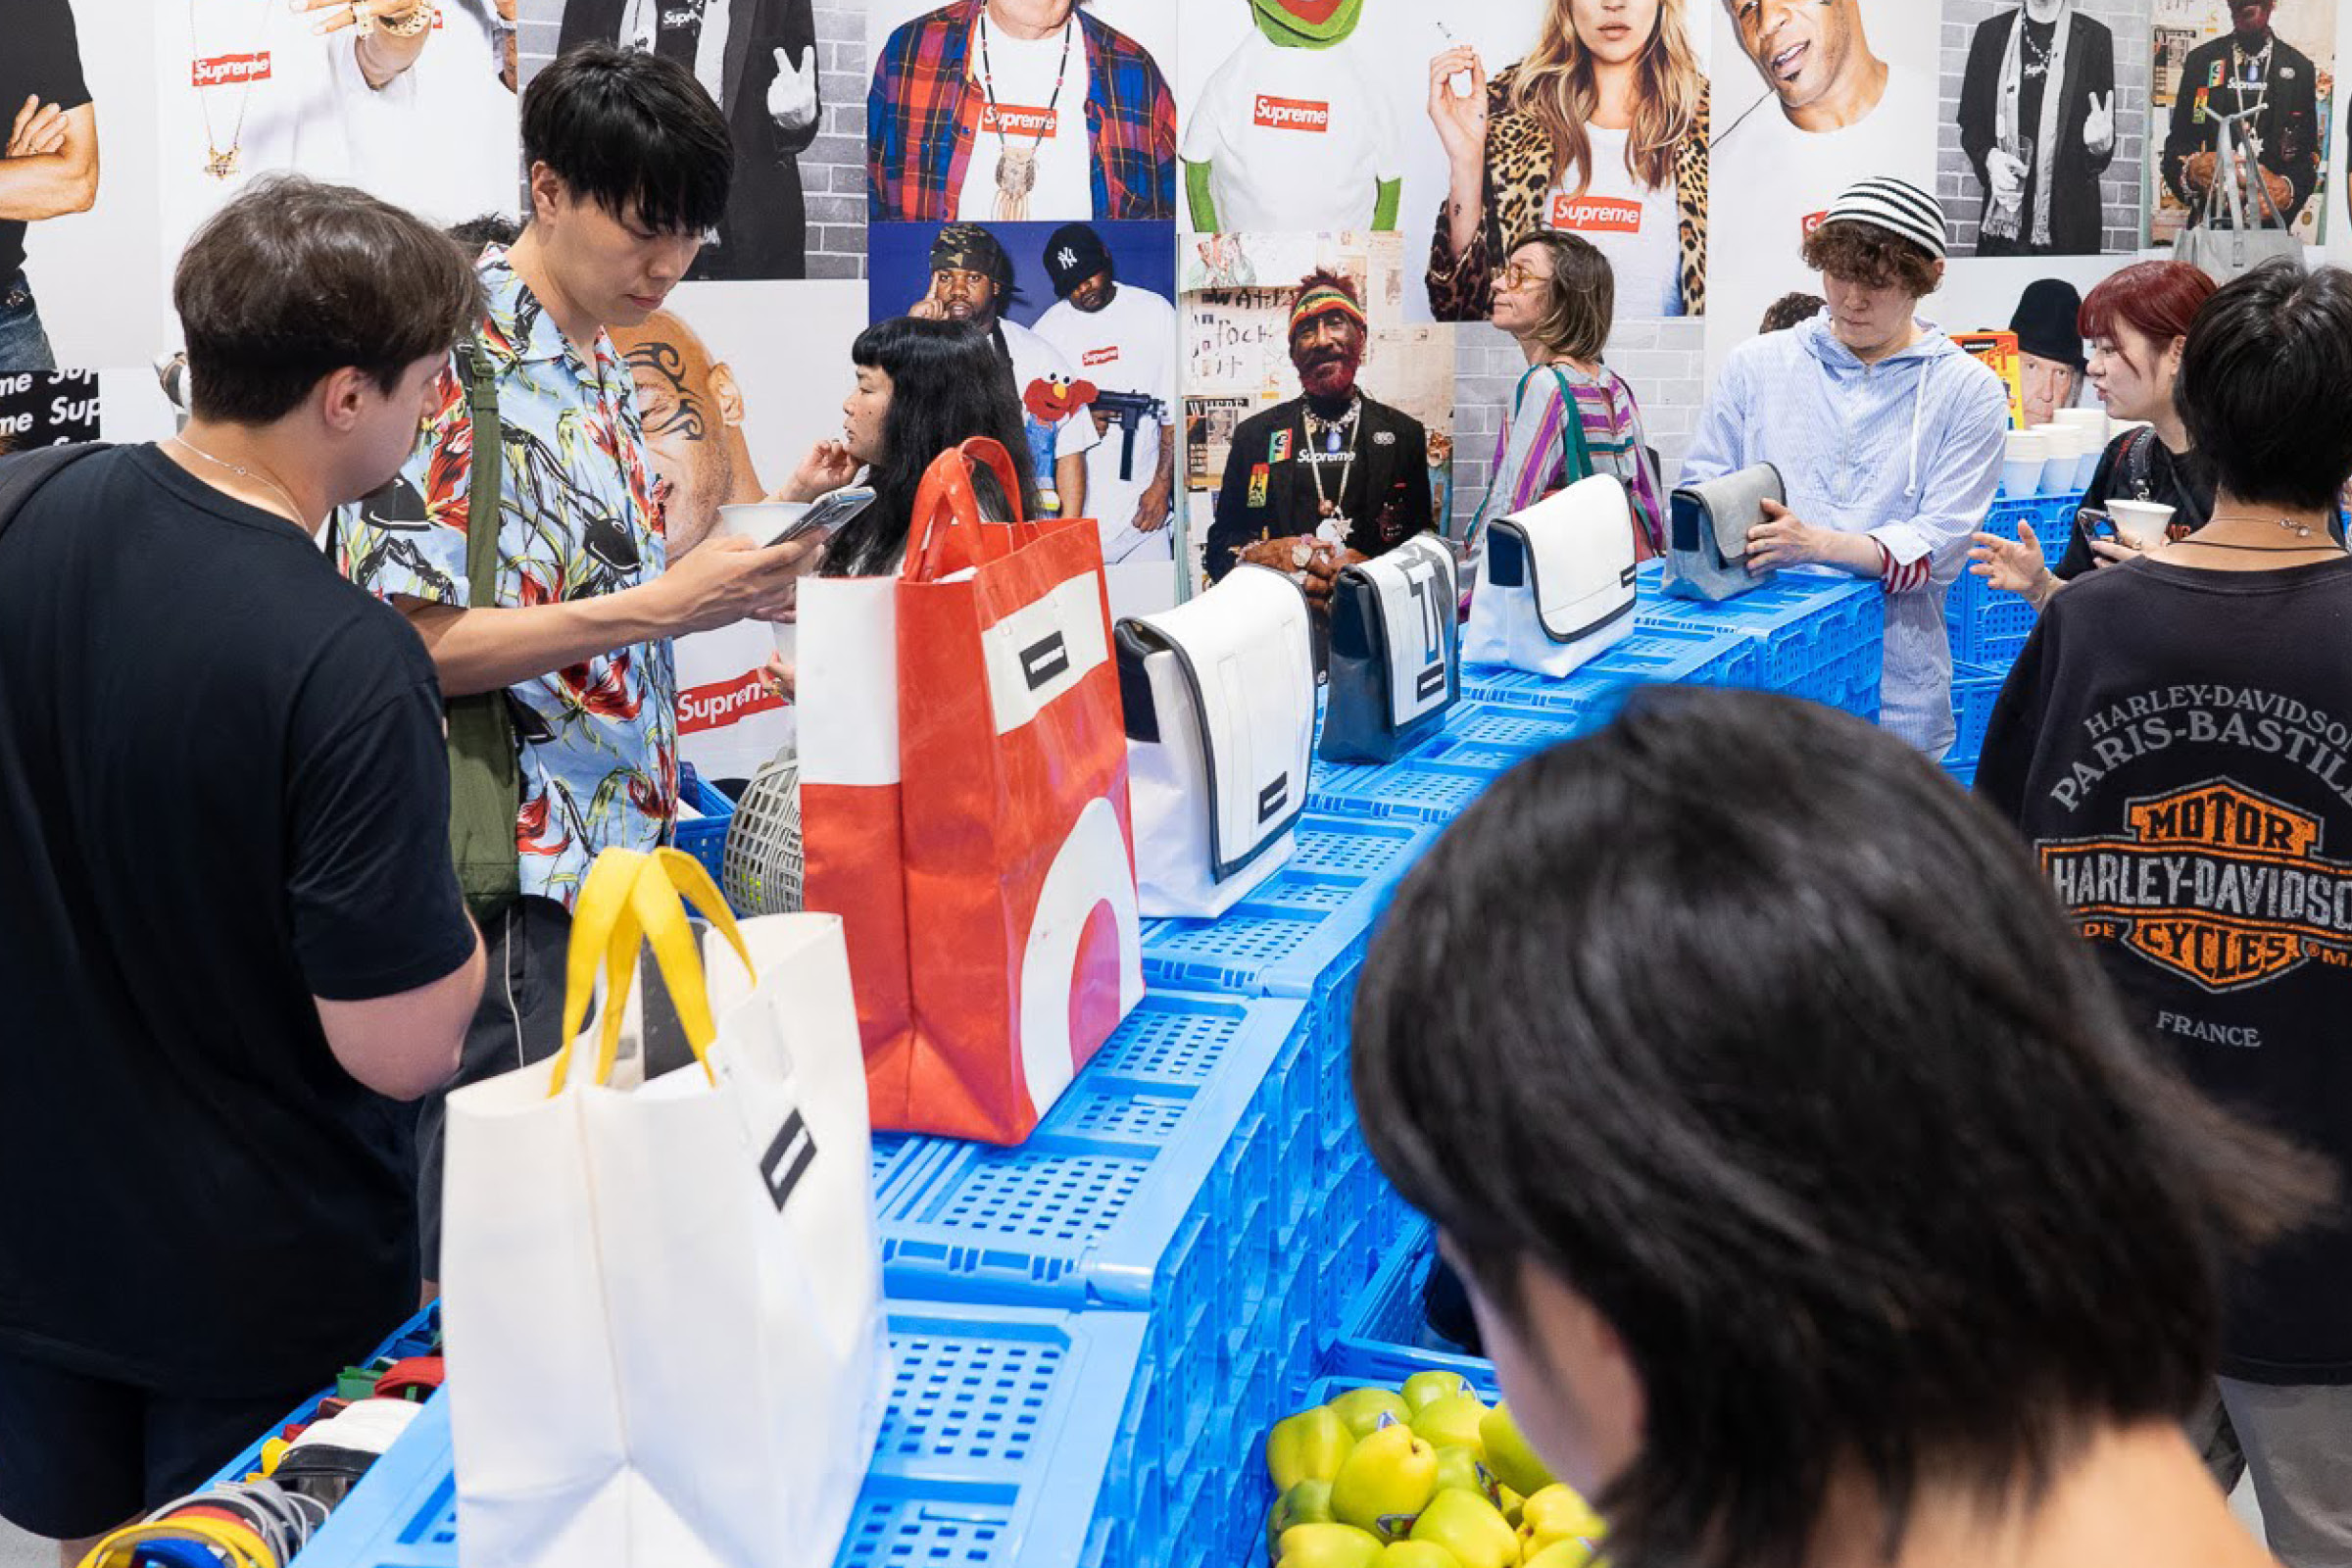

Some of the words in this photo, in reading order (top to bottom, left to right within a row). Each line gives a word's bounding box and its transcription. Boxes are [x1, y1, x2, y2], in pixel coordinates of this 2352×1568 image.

[194, 59, 270, 84] Supreme
[982, 105, 1055, 132] Supreme
[1256, 98, 1326, 126] Supreme
[1555, 198, 1640, 227] Supreme
[1297, 448, 1356, 463] Supreme
[2146, 790, 2294, 851] MOTOR
[2141, 922, 2289, 980] CYCLES
[2155, 1009, 2263, 1049] FRANCE
